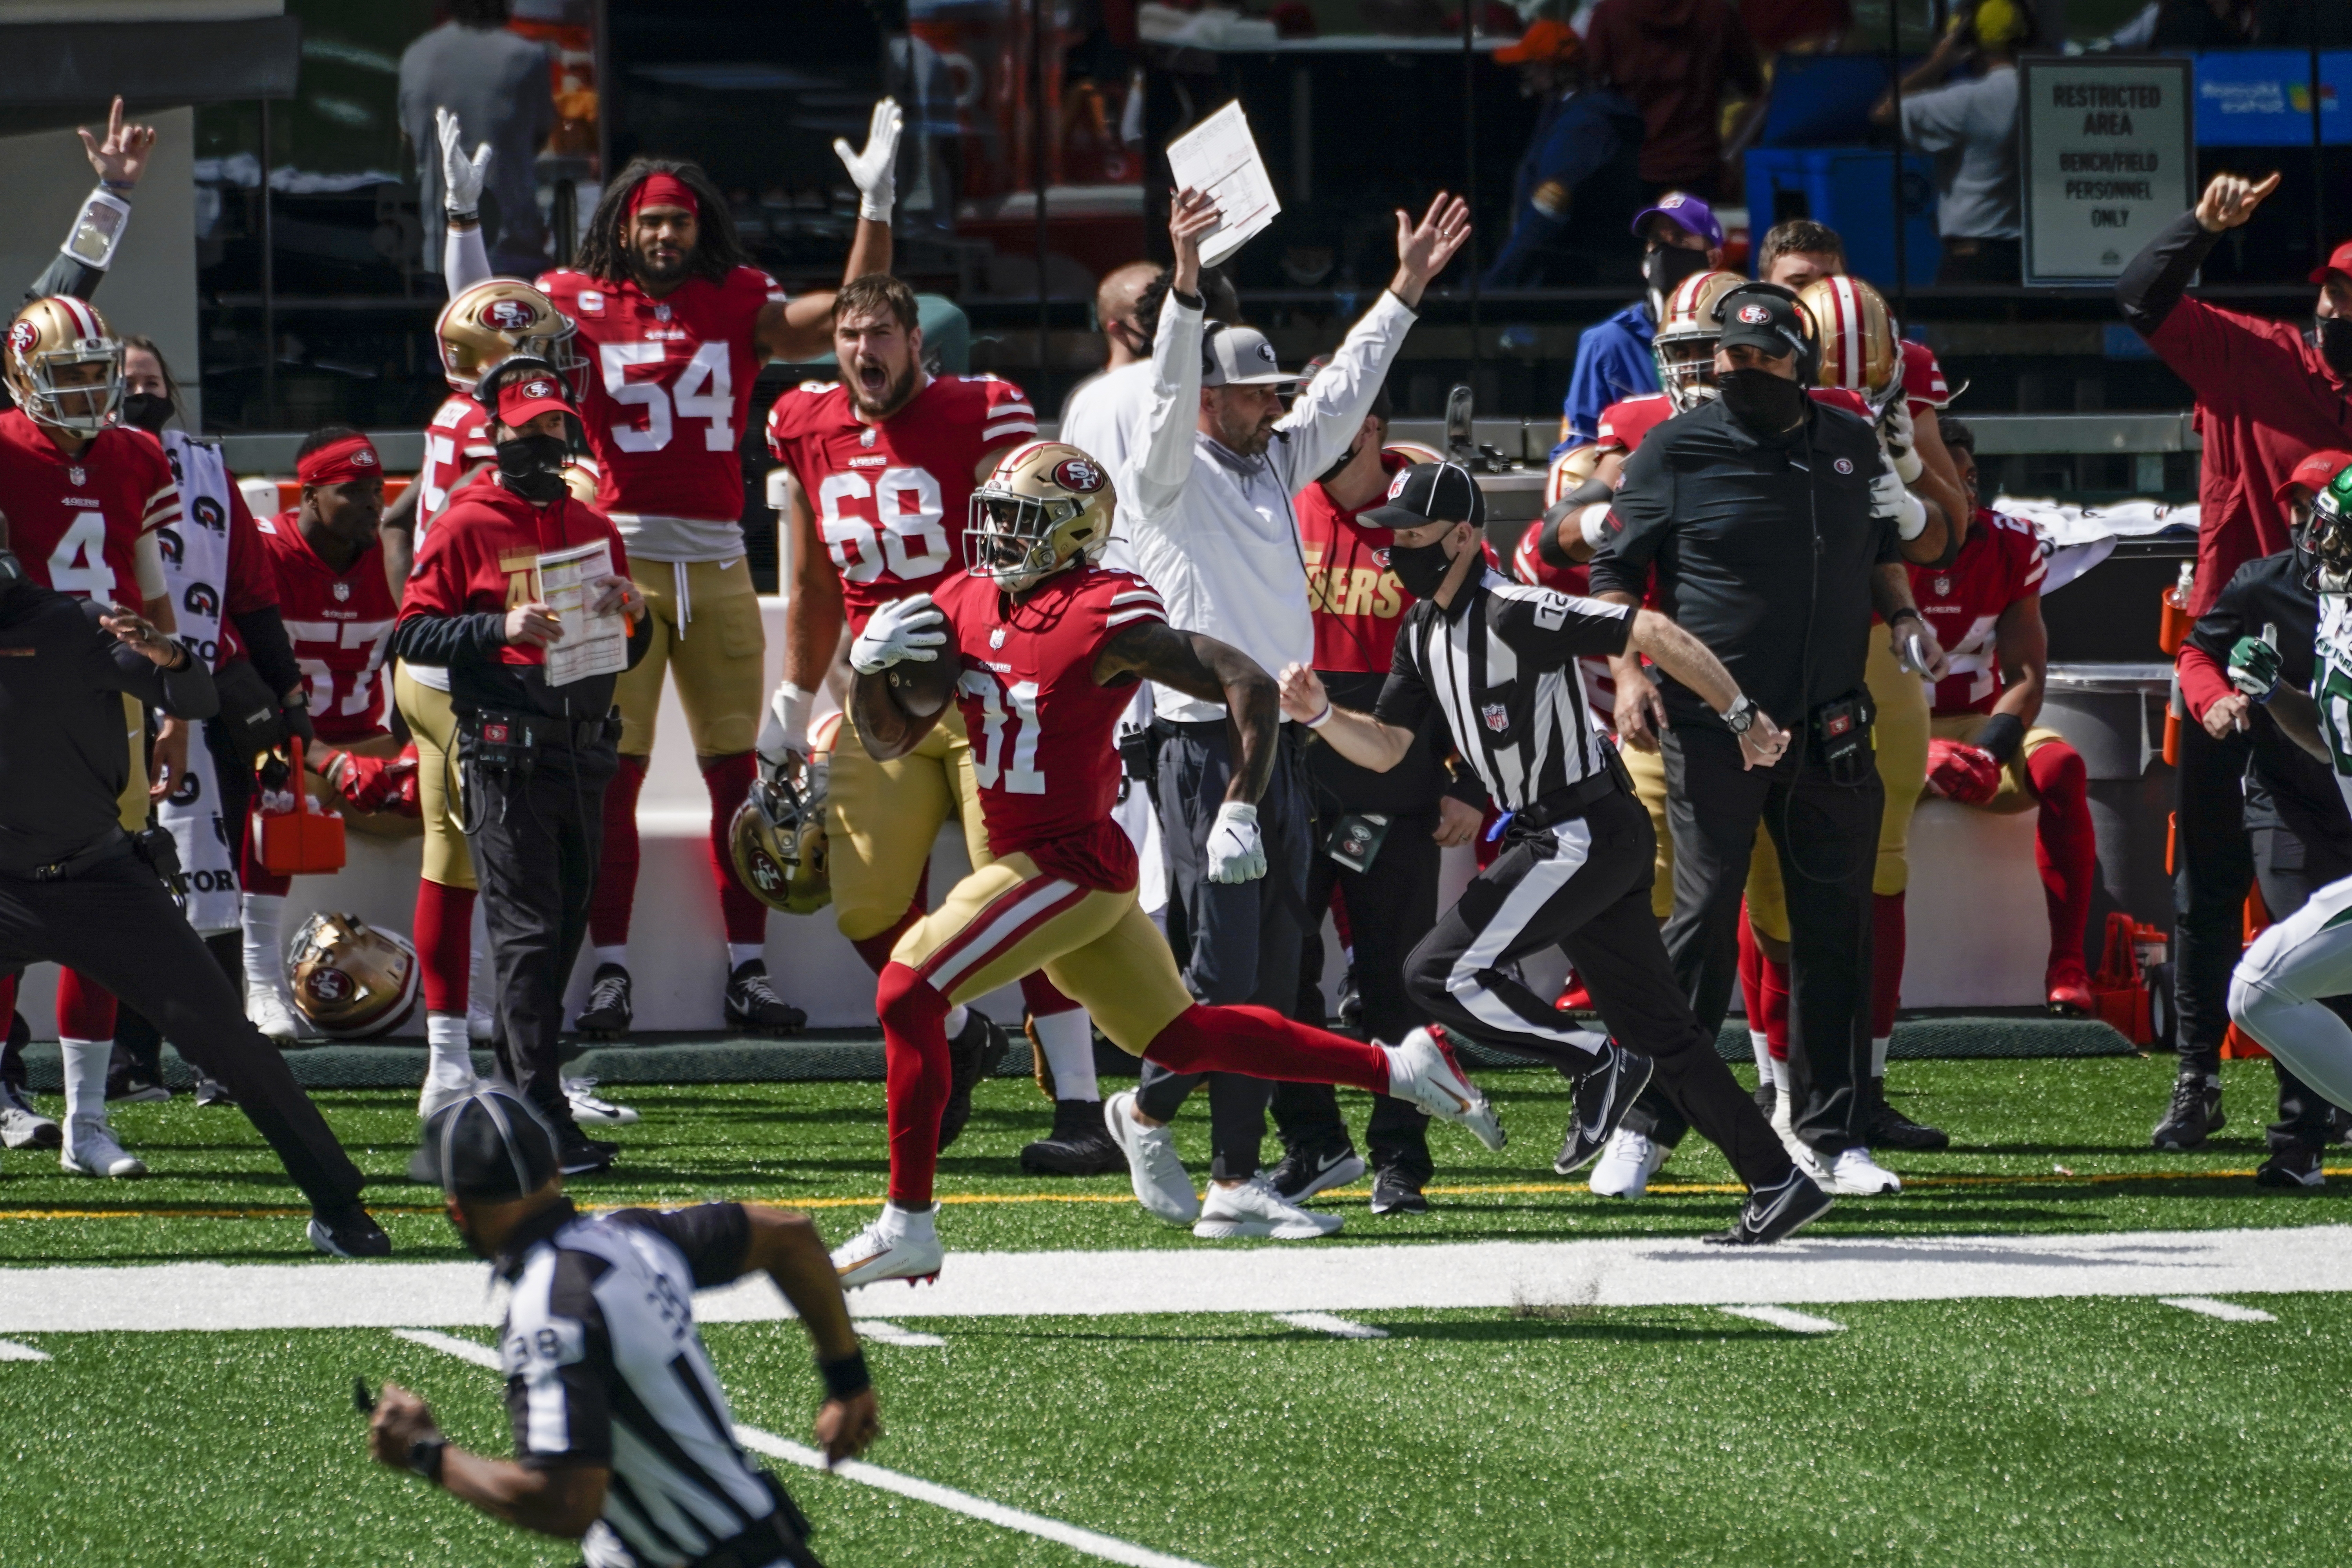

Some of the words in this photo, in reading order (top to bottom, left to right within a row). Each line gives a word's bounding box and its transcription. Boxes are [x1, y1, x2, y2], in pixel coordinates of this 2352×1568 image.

[2053, 86, 2161, 108] RESTRICTED
[2083, 114, 2133, 136] AREA
[2060, 153, 2158, 171] BENCH/FIELD
[2066, 181, 2152, 200] PERSONNEL
[2091, 209, 2130, 227] ONLY
[578, 292, 604, 310] C
[599, 339, 735, 453] 54
[848, 457, 887, 467] 49ERS
[818, 467, 951, 583] 68
[47, 512, 116, 611] 4
[1541, 592, 1568, 619] 12
[956, 669, 1045, 795] 31
[1487, 714, 1507, 728] NFL
